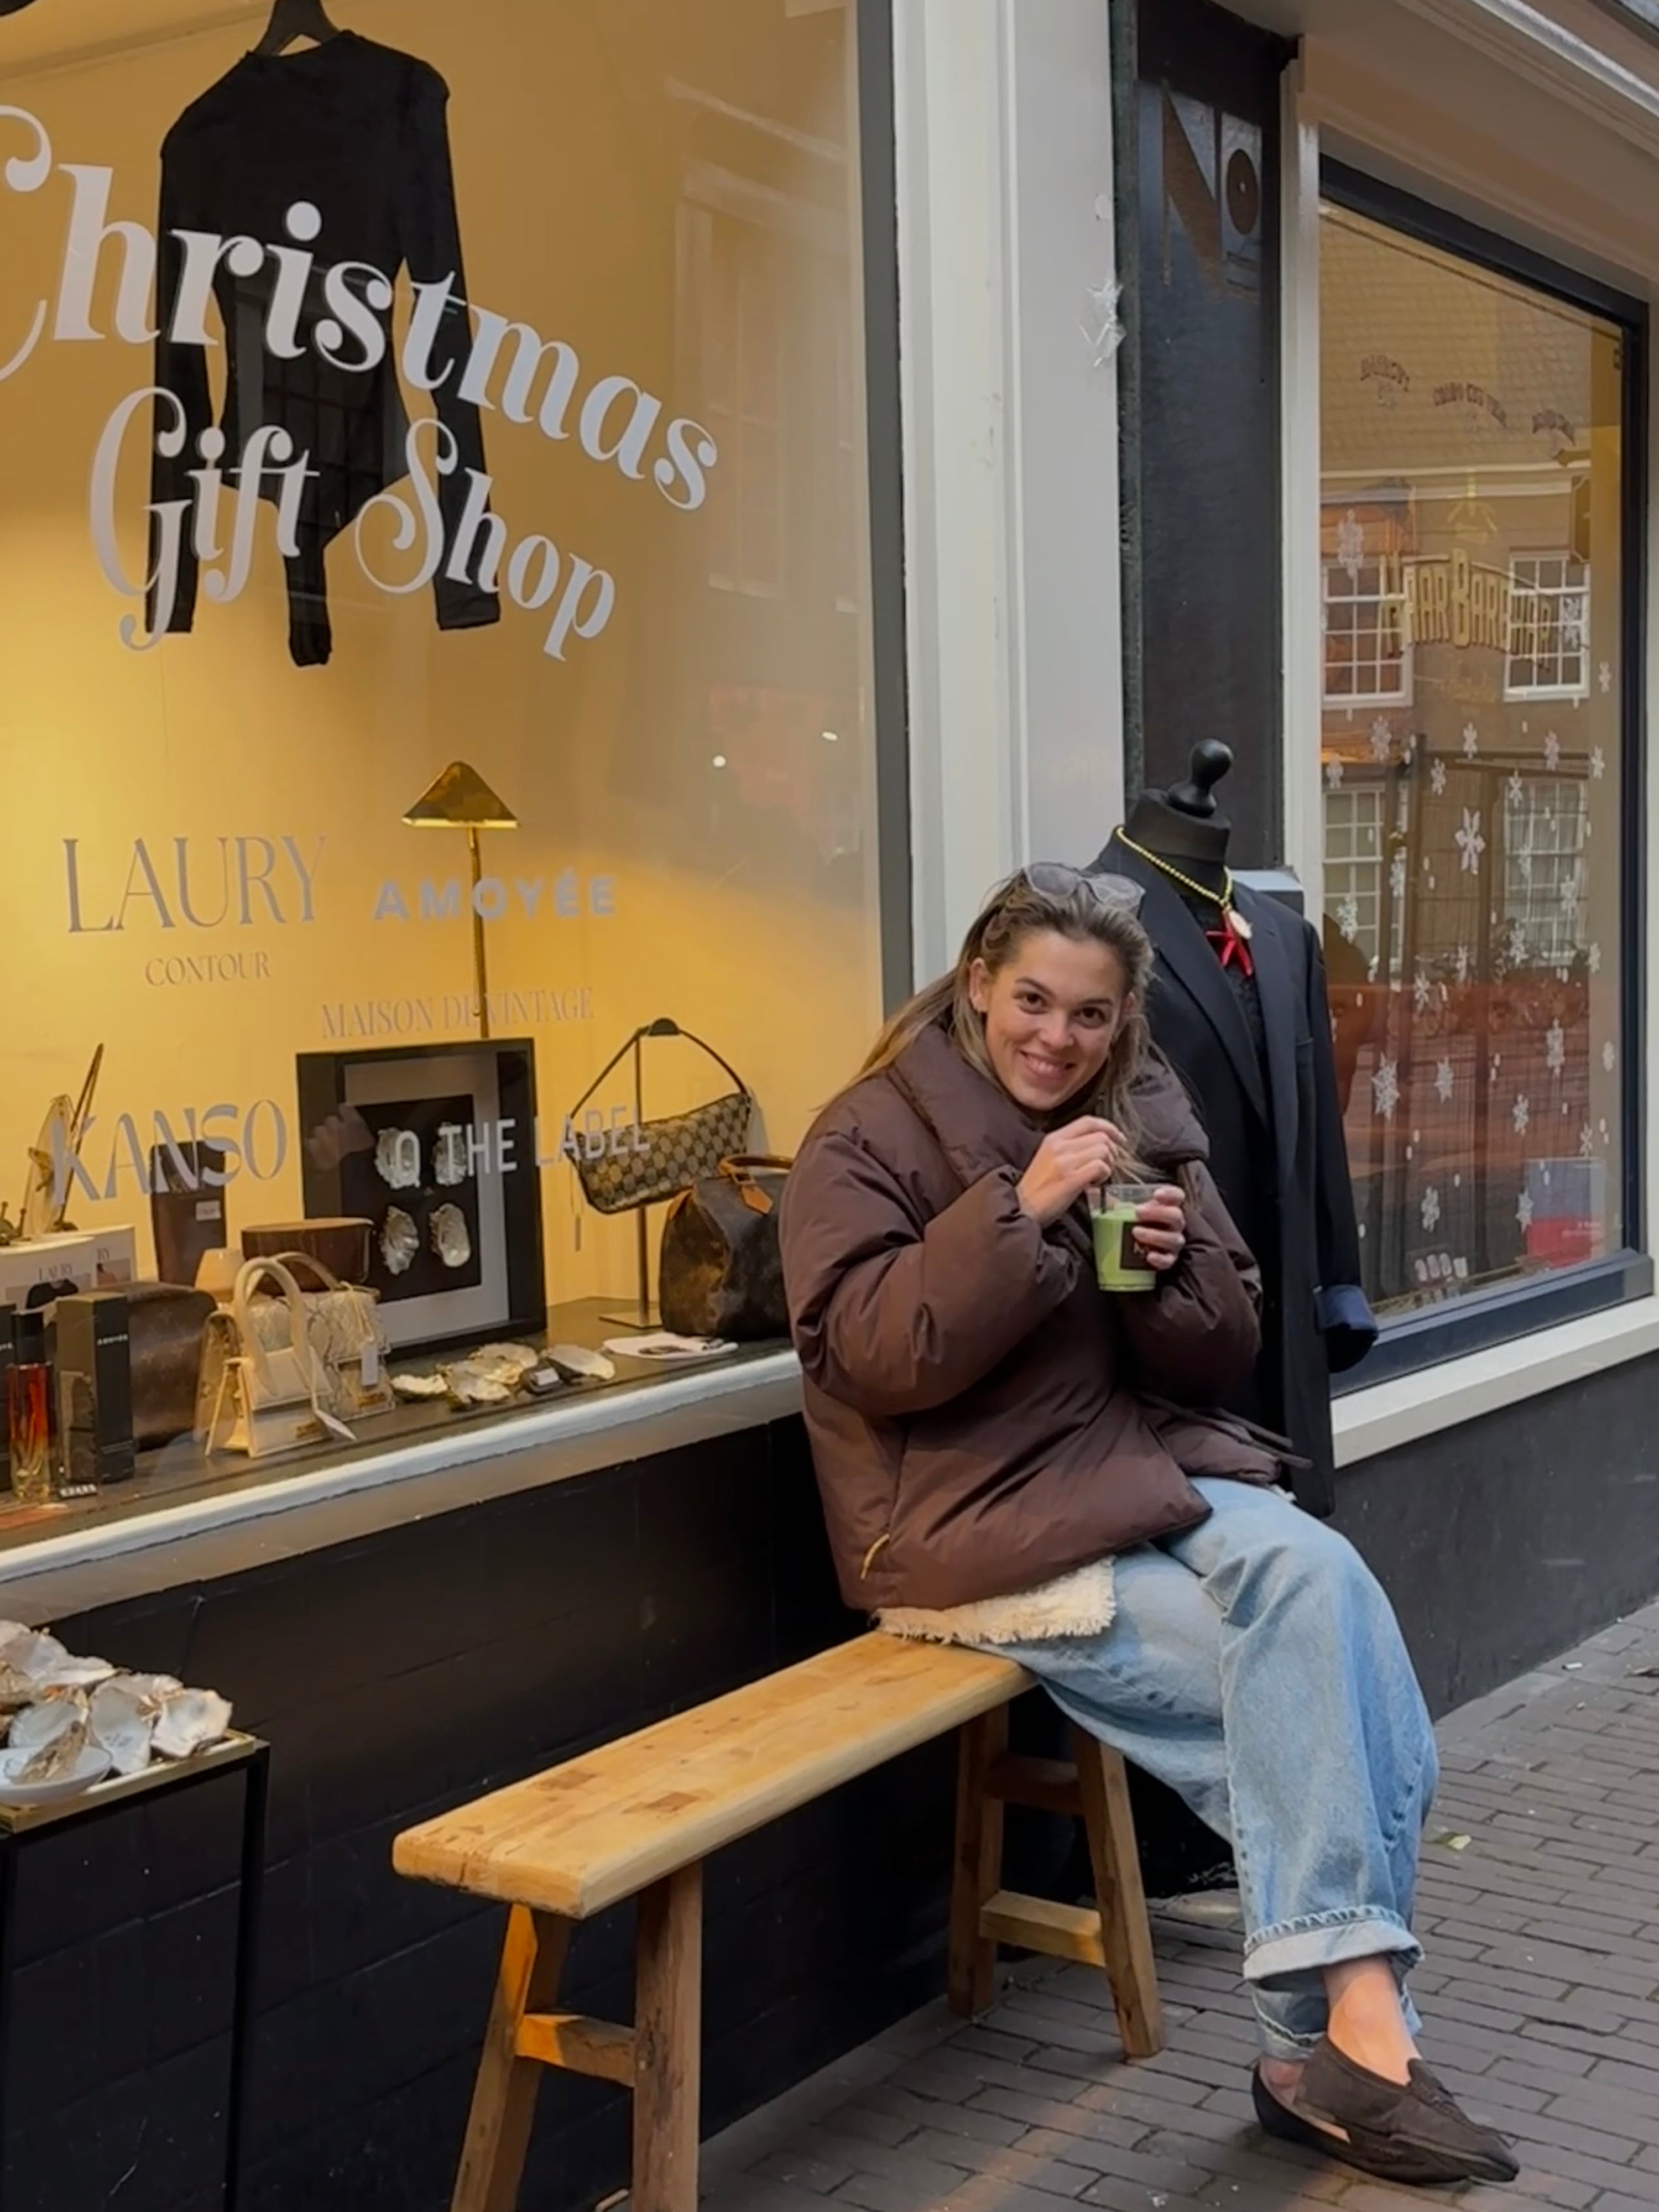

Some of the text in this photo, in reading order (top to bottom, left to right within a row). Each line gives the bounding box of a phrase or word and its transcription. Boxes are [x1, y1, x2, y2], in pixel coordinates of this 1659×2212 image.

[90, 386, 616, 661] Gift Shop
[62, 836, 329, 933] LAURY
[373, 865, 617, 921] AMOYÉE
[145, 951, 271, 987] CONTOUR
[321, 997, 434, 1040] MAISON
[480, 987, 594, 1025] VINTAGE
[49, 1099, 287, 1207] KANSO
[439, 1118, 518, 1179] THE
[535, 1105, 651, 1167] LABEL
